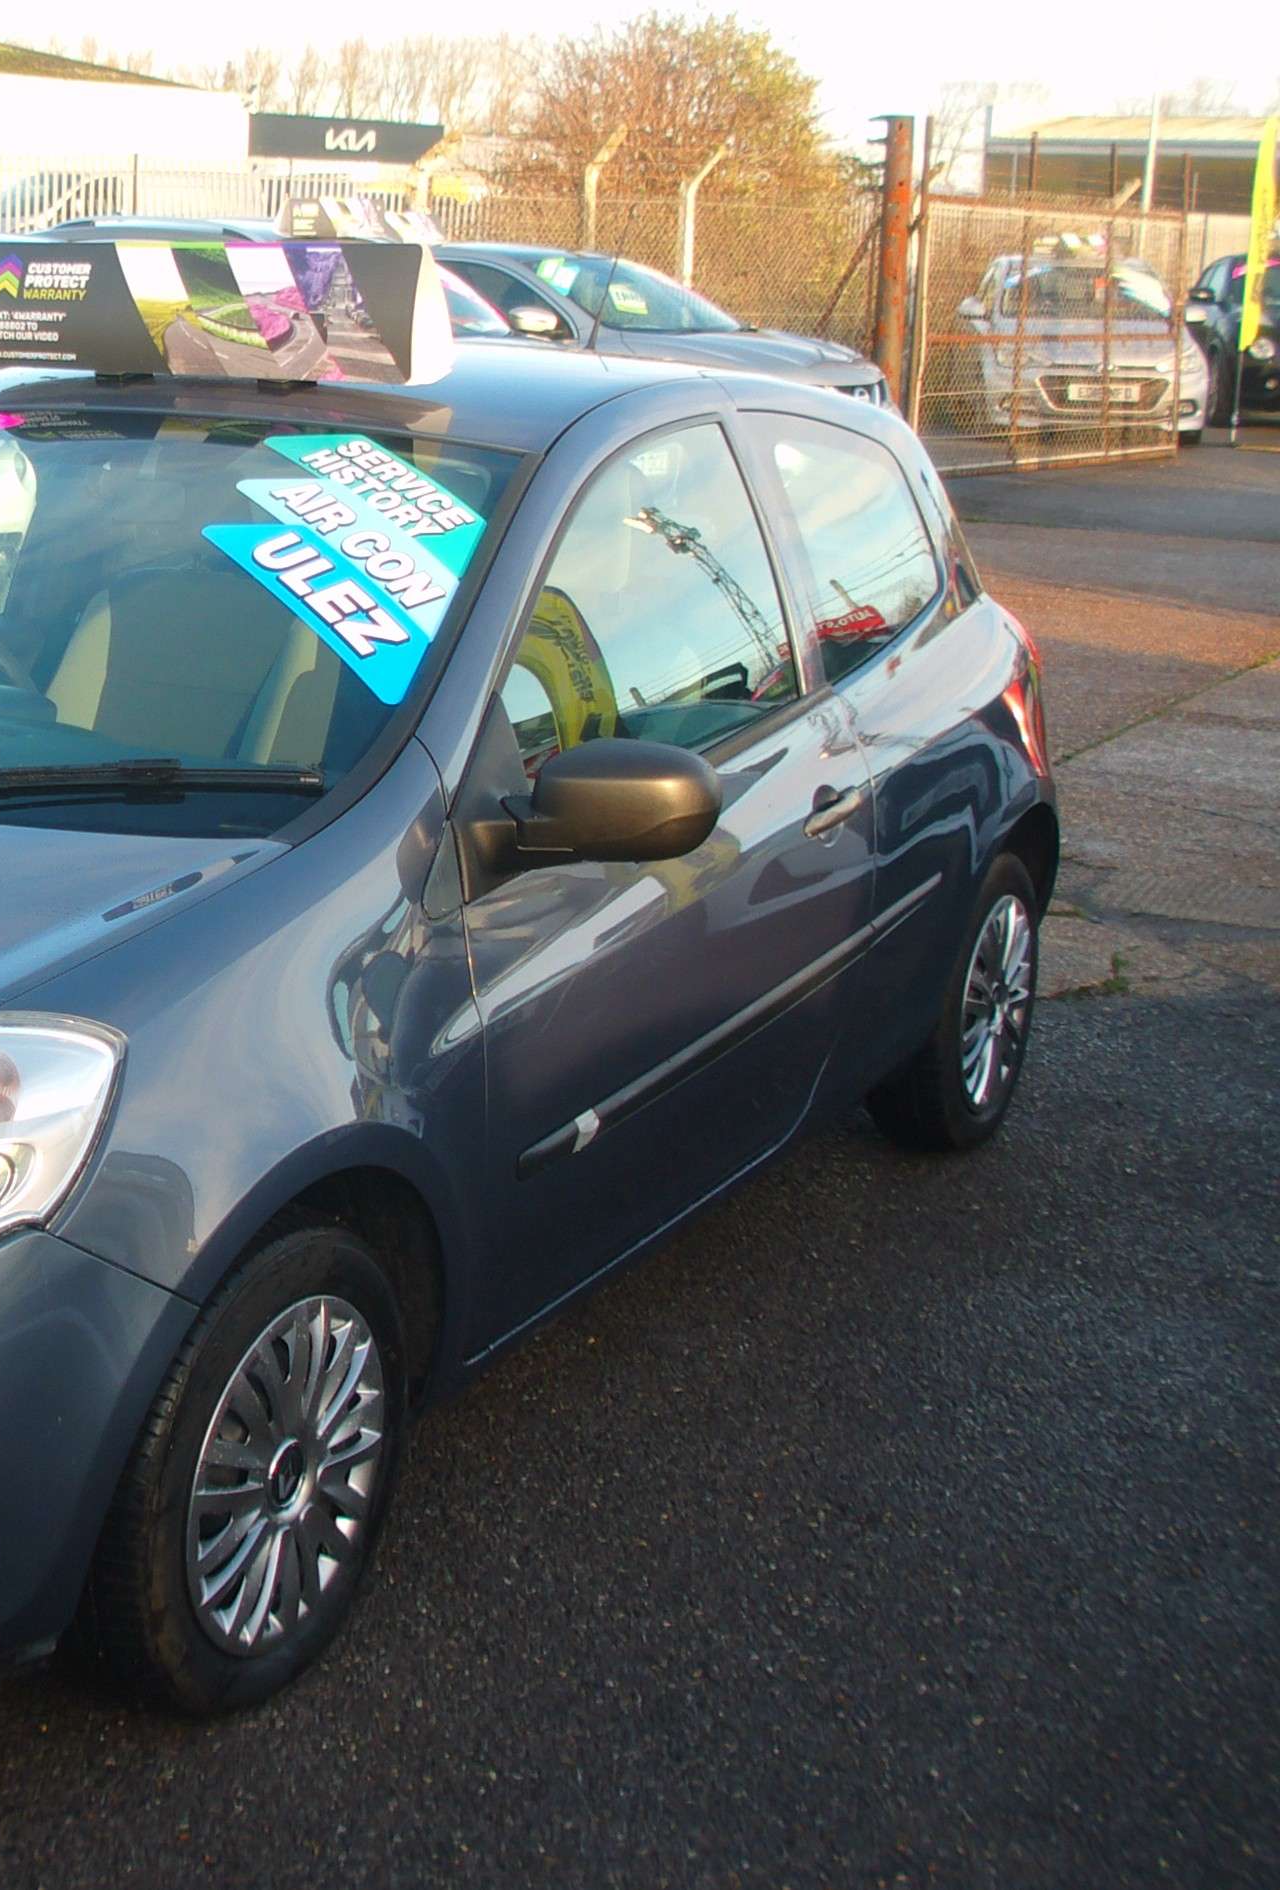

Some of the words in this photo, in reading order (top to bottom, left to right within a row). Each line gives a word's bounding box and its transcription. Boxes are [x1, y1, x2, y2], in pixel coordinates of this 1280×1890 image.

[27, 263, 91, 275] CUSTOMER
[24, 274, 89, 288] PROTECT
[23, 288, 87, 301] WARRANTY
[27, 322, 38, 331] TO
[16, 331, 33, 341] OUR
[34, 332, 59, 342] VIDEO
[336, 440, 476, 531] SERVICE
[300, 449, 446, 538] HISTORY
[270, 482, 357, 535] AIR
[340, 530, 447, 610] CON
[251, 531, 411, 660] ULEZ
